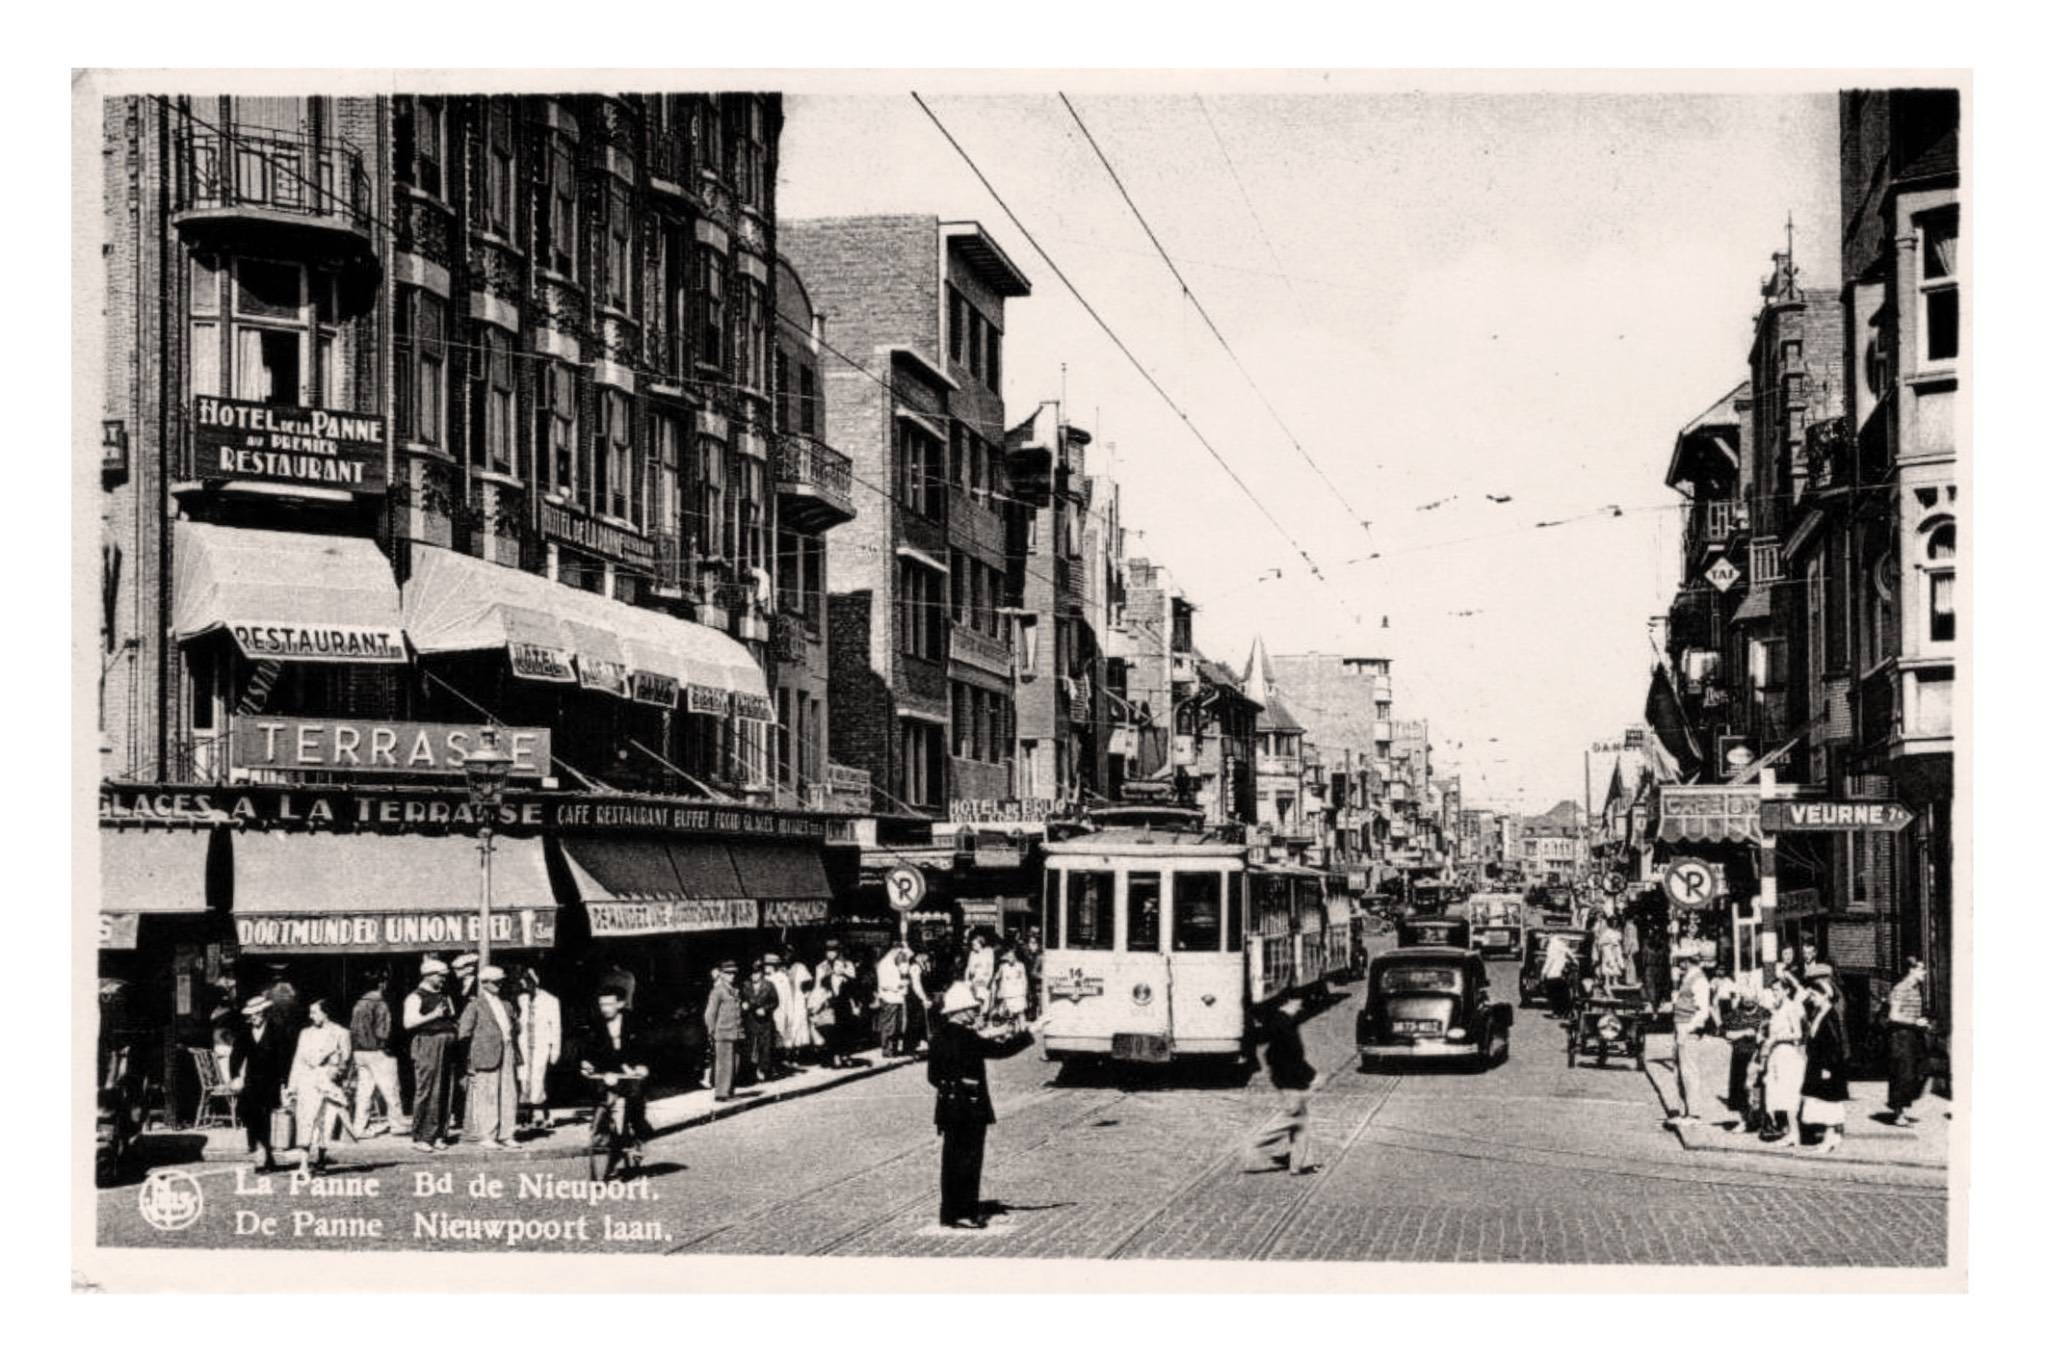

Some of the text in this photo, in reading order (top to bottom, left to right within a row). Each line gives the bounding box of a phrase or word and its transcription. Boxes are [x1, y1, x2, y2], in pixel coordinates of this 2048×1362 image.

[200, 399, 279, 432] HOTEL
[311, 410, 384, 443] PANNE
[270, 433, 338, 456] PREMIER
[219, 445, 366, 483] RESTAURANT
[235, 626, 390, 655] RESTAURANT
[257, 721, 537, 771] TERRASE
[99, 794, 543, 825] GLACES A LA TERRASE
[557, 804, 590, 826] CAFE
[595, 805, 668, 826] RESTAURANT
[949, 799, 998, 817] HOTEL
[1790, 804, 1884, 824] VEURNE
[238, 917, 378, 945] DORTMUNDER
[385, 914, 463, 943] UNION
[467, 914, 513, 941] BER
[1069, 967, 1084, 979] 14
